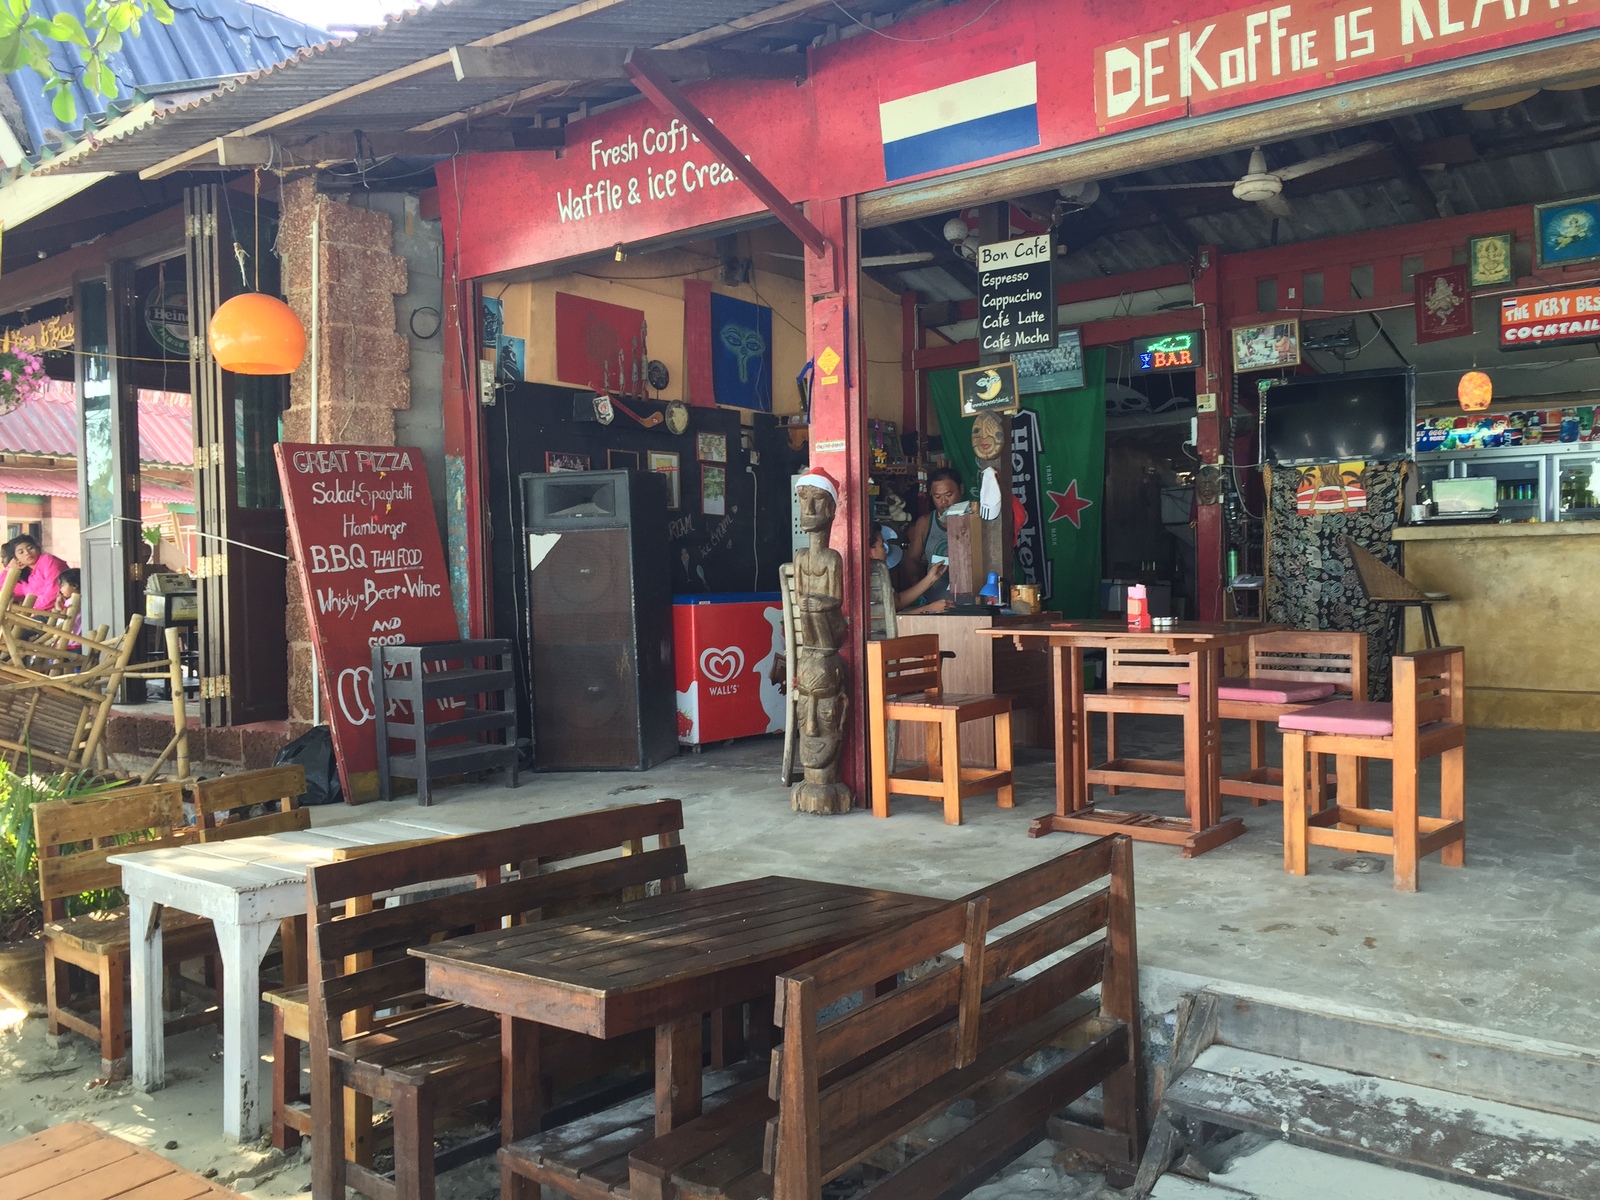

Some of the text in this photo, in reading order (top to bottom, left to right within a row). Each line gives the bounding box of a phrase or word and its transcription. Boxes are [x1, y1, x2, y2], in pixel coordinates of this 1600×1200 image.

[1335, 7, 1374, 62] IS
[591, 118, 714, 171] Fresh Coff
[556, 155, 751, 223] Waffle & ice Crea
[981, 236, 1048, 264] Bon Café
[981, 272, 1029, 290] Espresso
[982, 288, 1042, 311] Cappuccino
[1505, 303, 1530, 322] THE
[1534, 296, 1571, 318] VERY
[153, 308, 189, 321] Hein
[982, 310, 1046, 329] Café Latte
[983, 327, 1050, 350] Café Mocha
[1153, 350, 1193, 368] BAR
[293, 450, 413, 474] GREAT PIZZA
[343, 513, 407, 540] Hamburger
[371, 550, 396, 568] THAI
[398, 548, 423, 567] FOOD
[371, 616, 402, 632] AND
[368, 633, 406, 647] GOOD
[709, 684, 738, 696] WALL'S
